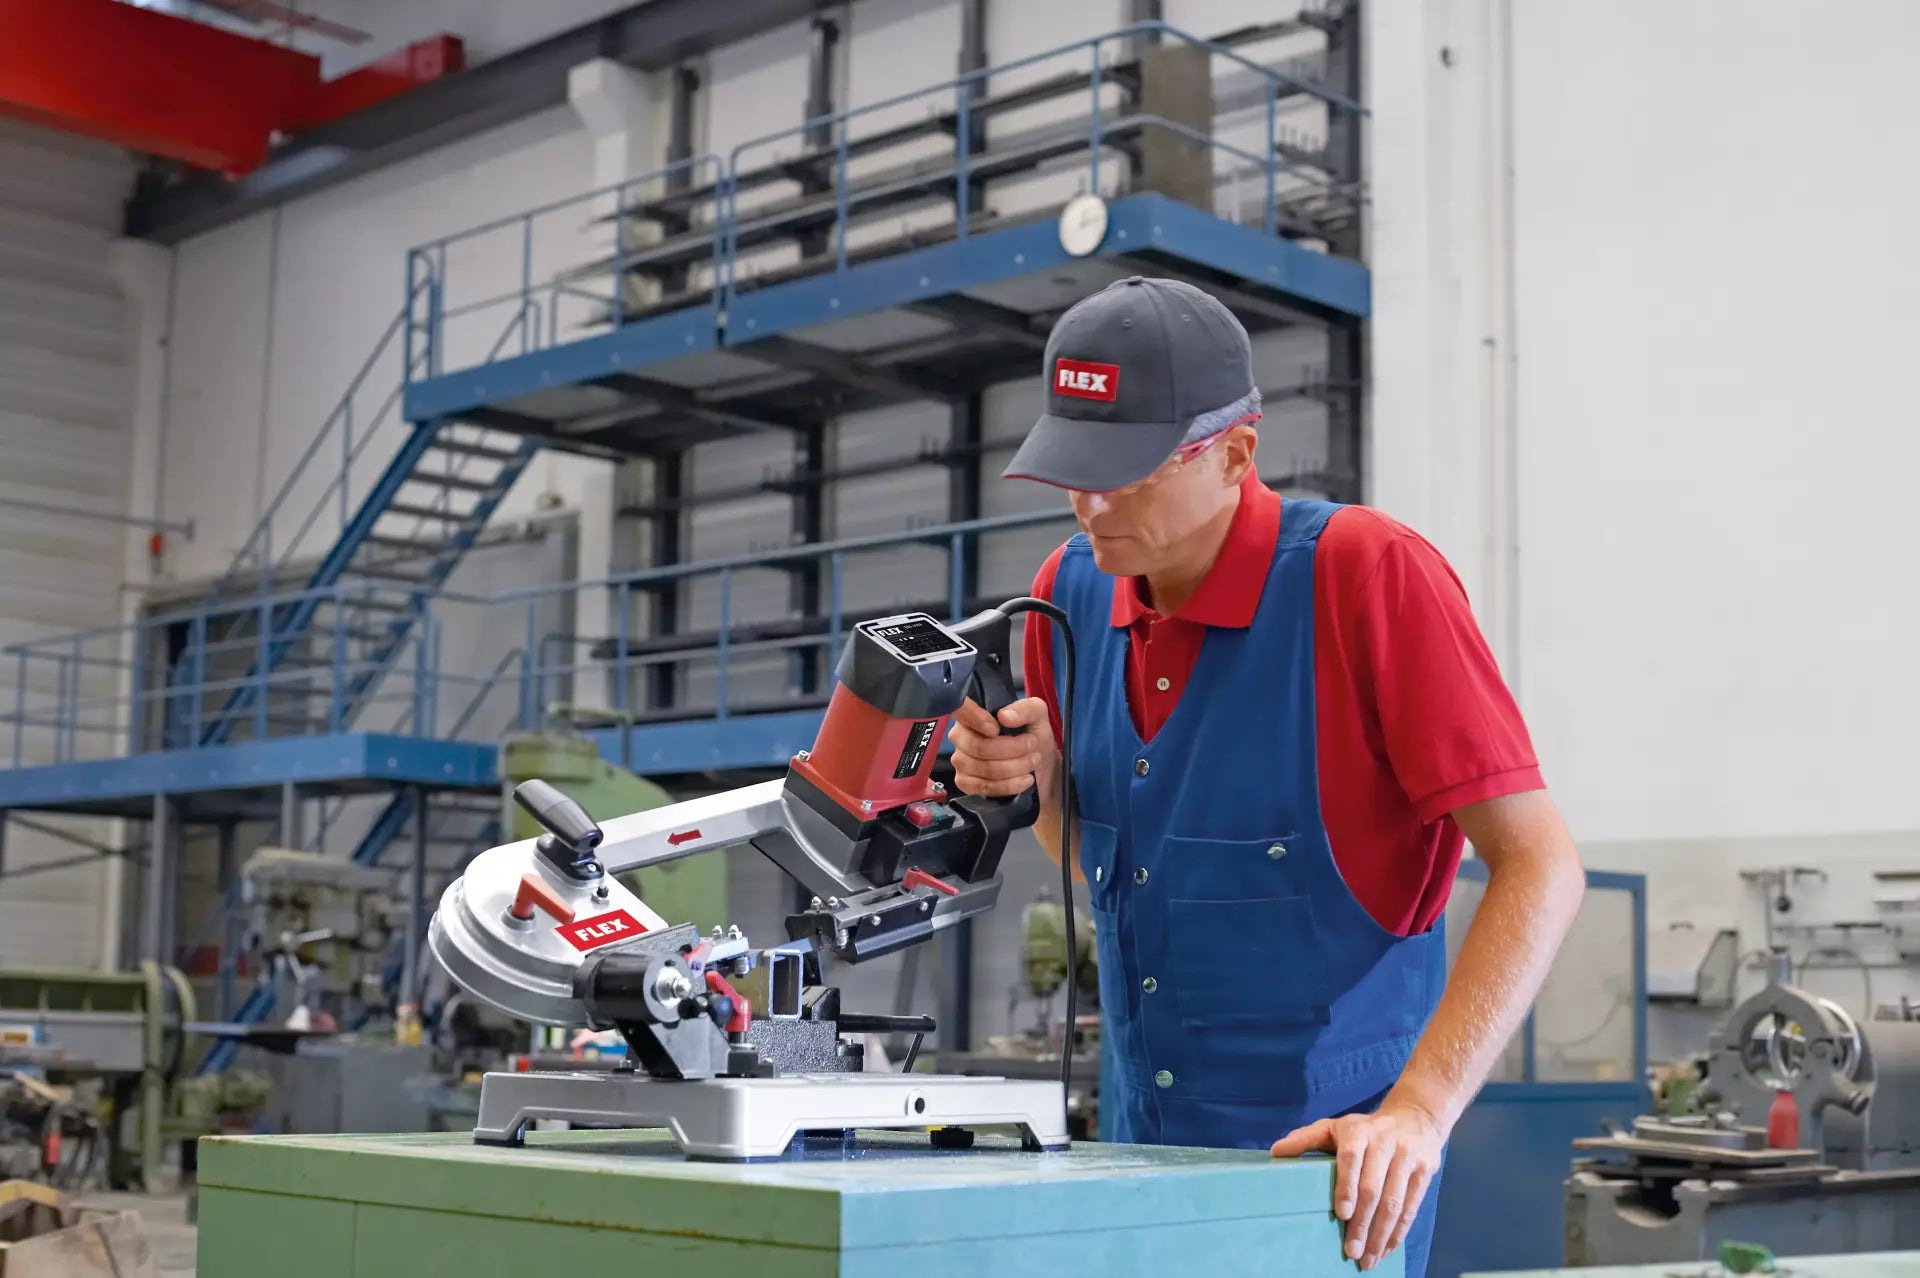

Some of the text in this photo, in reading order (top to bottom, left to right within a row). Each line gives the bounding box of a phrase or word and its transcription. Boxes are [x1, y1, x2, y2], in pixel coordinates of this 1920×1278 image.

[1059, 369, 1109, 393] FLEX
[877, 626, 904, 637] FLEX
[919, 721, 937, 748] FLEX
[574, 918, 631, 942] FLEX
